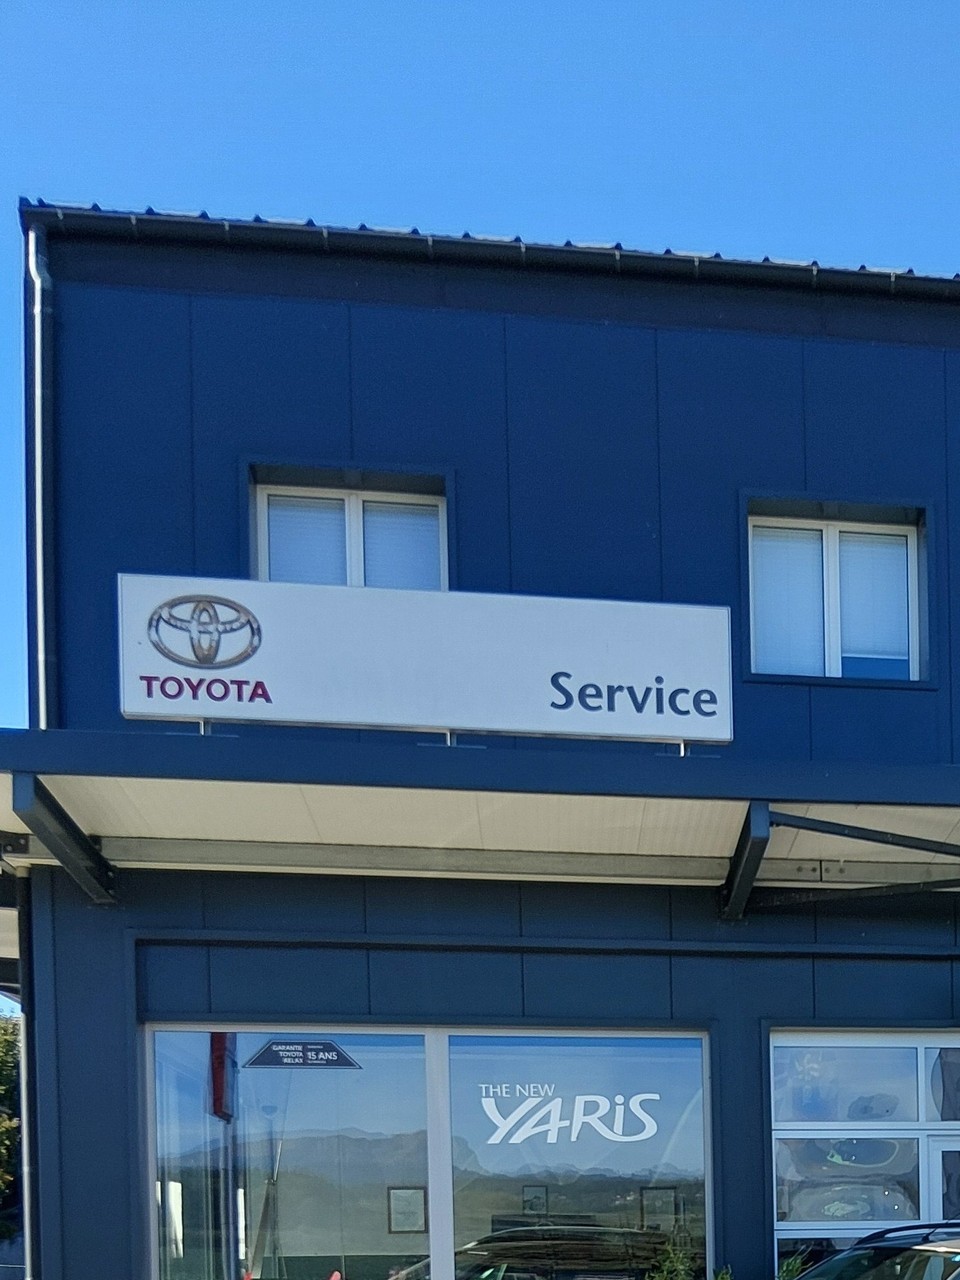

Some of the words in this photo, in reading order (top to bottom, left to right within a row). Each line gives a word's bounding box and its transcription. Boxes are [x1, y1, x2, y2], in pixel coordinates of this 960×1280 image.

[139, 675, 273, 704] TOYOTA
[550, 671, 718, 717] Service
[307, 1052, 317, 1060] 15
[318, 1052, 338, 1060] ANS
[479, 1084, 510, 1097] THE
[516, 1084, 555, 1097] NEW
